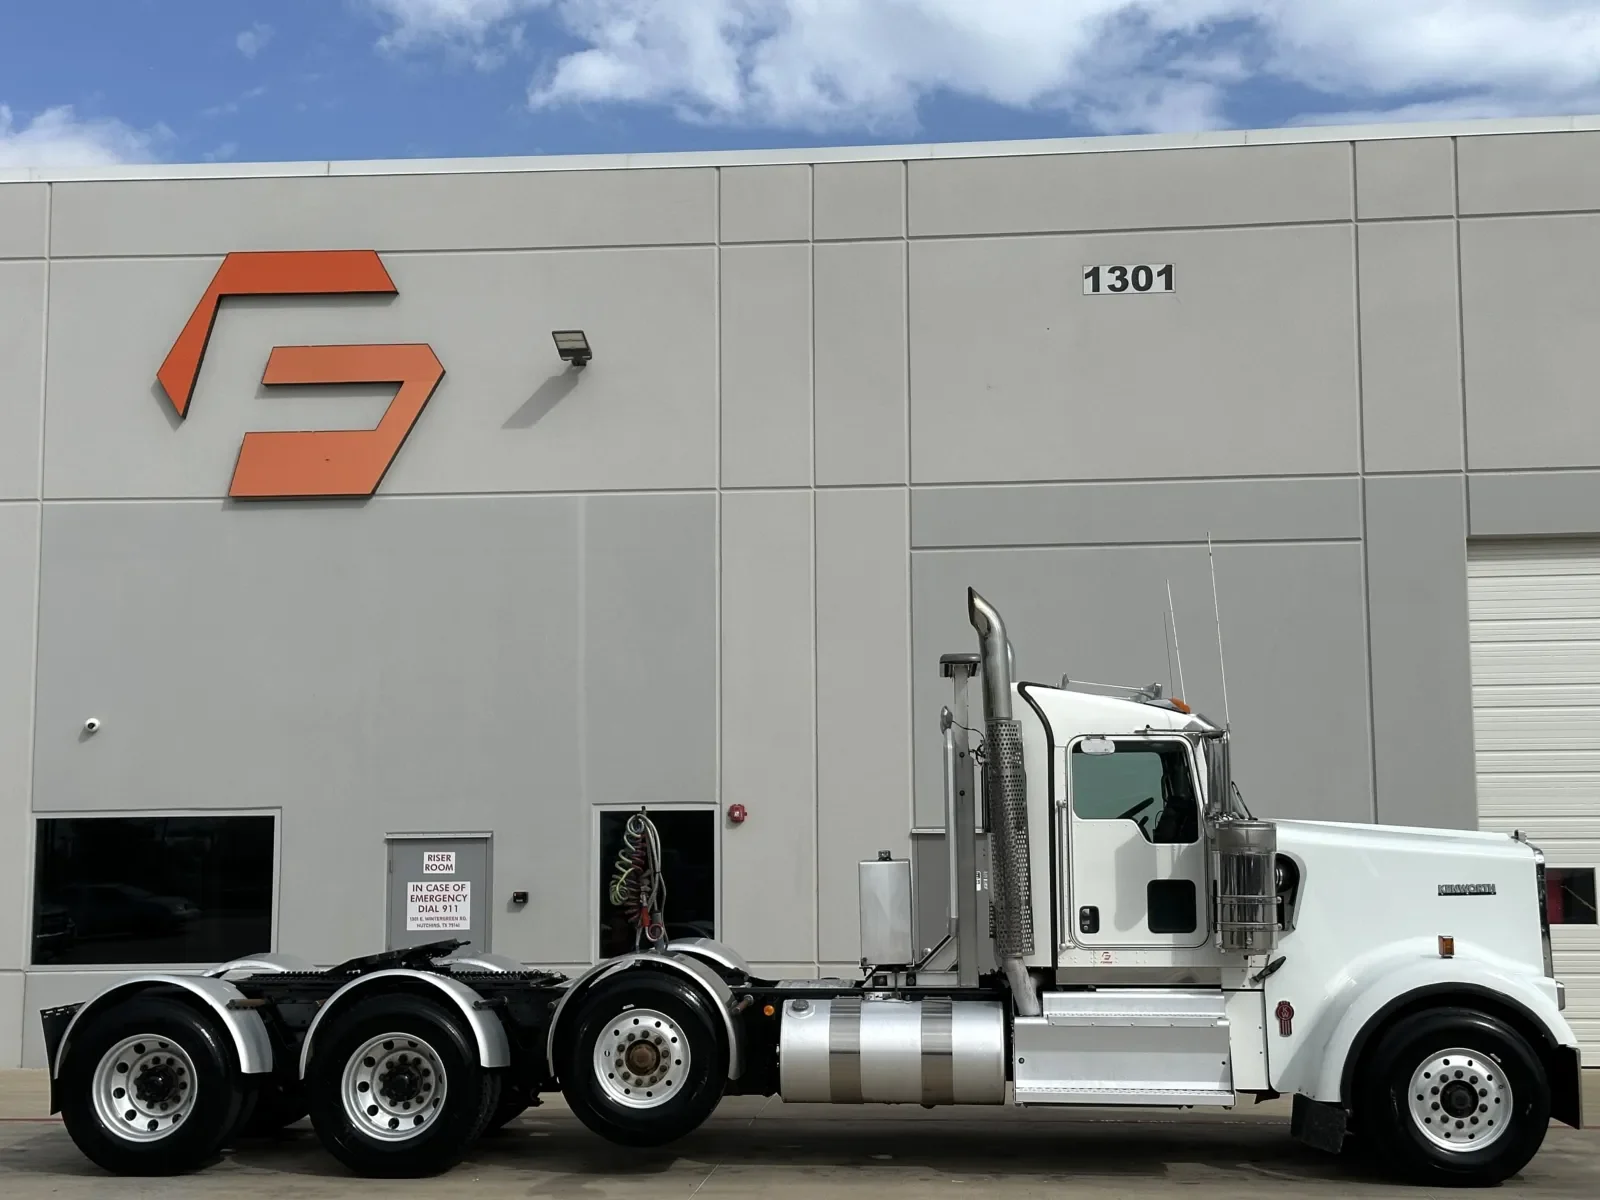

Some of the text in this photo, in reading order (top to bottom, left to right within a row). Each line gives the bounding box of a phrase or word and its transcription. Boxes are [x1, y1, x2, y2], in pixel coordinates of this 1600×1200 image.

[1084, 264, 1173, 293] 1301
[427, 854, 452, 862] RISER
[412, 884, 466, 892] IN CASE OF
[1438, 884, 1496, 894] KENWORTH
[410, 894, 468, 903] EMERGENCY
[418, 904, 458, 913] DIAL 911
